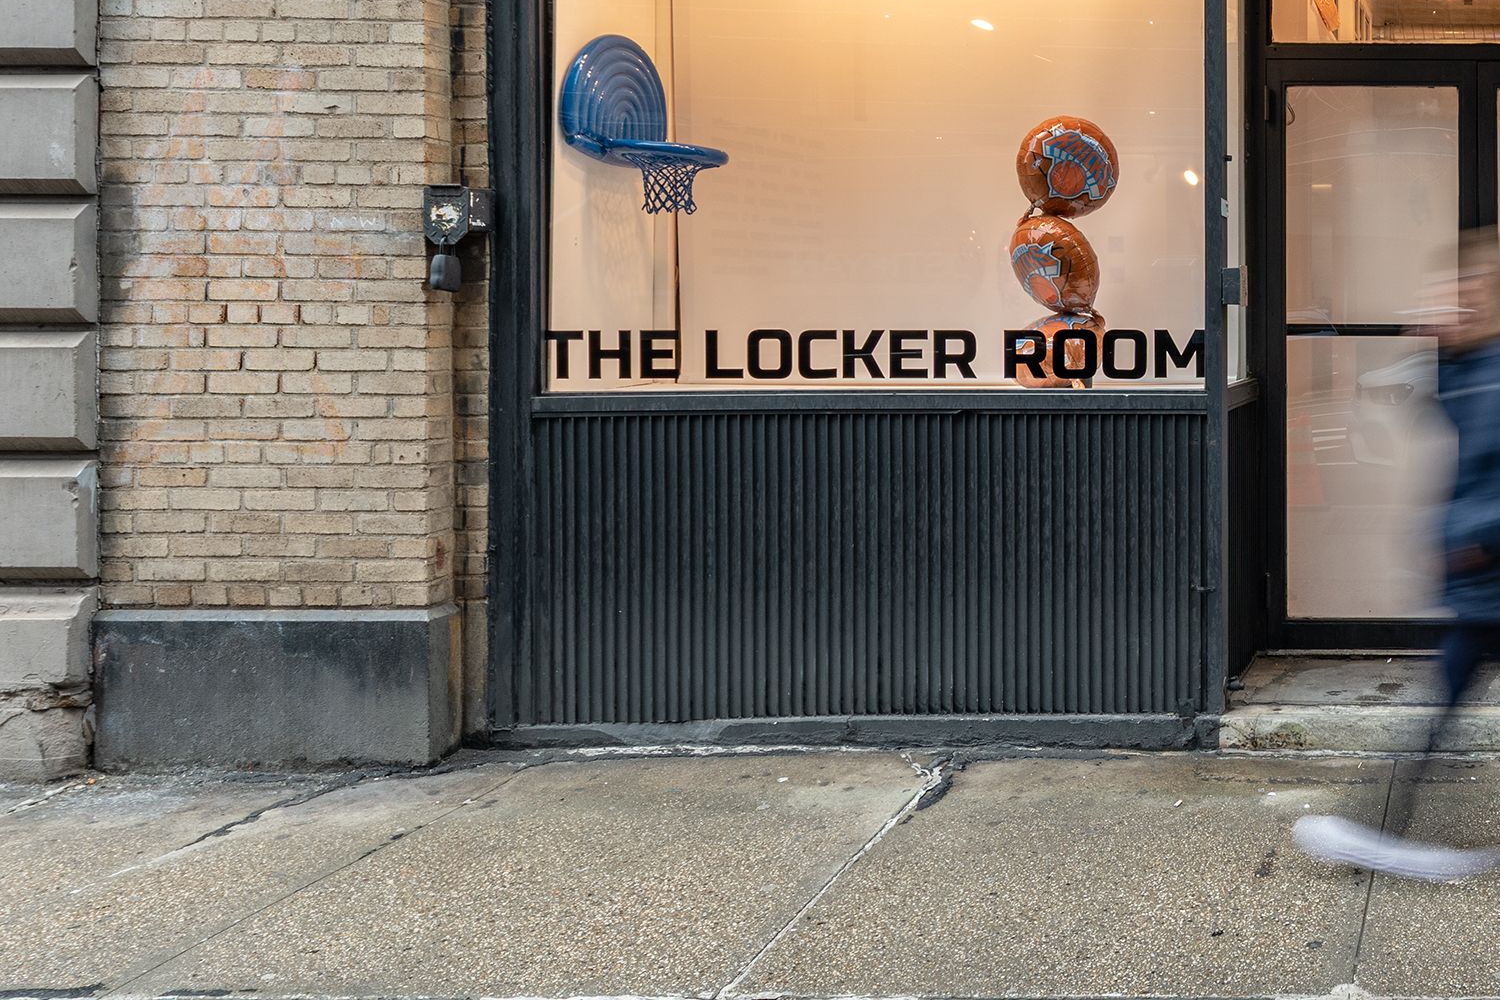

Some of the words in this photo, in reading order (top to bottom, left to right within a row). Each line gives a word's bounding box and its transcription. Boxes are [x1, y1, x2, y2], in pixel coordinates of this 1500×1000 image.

[545, 330, 680, 379] THE
[705, 330, 977, 379] LOCKER
[1003, 329, 1206, 379] ROOM
